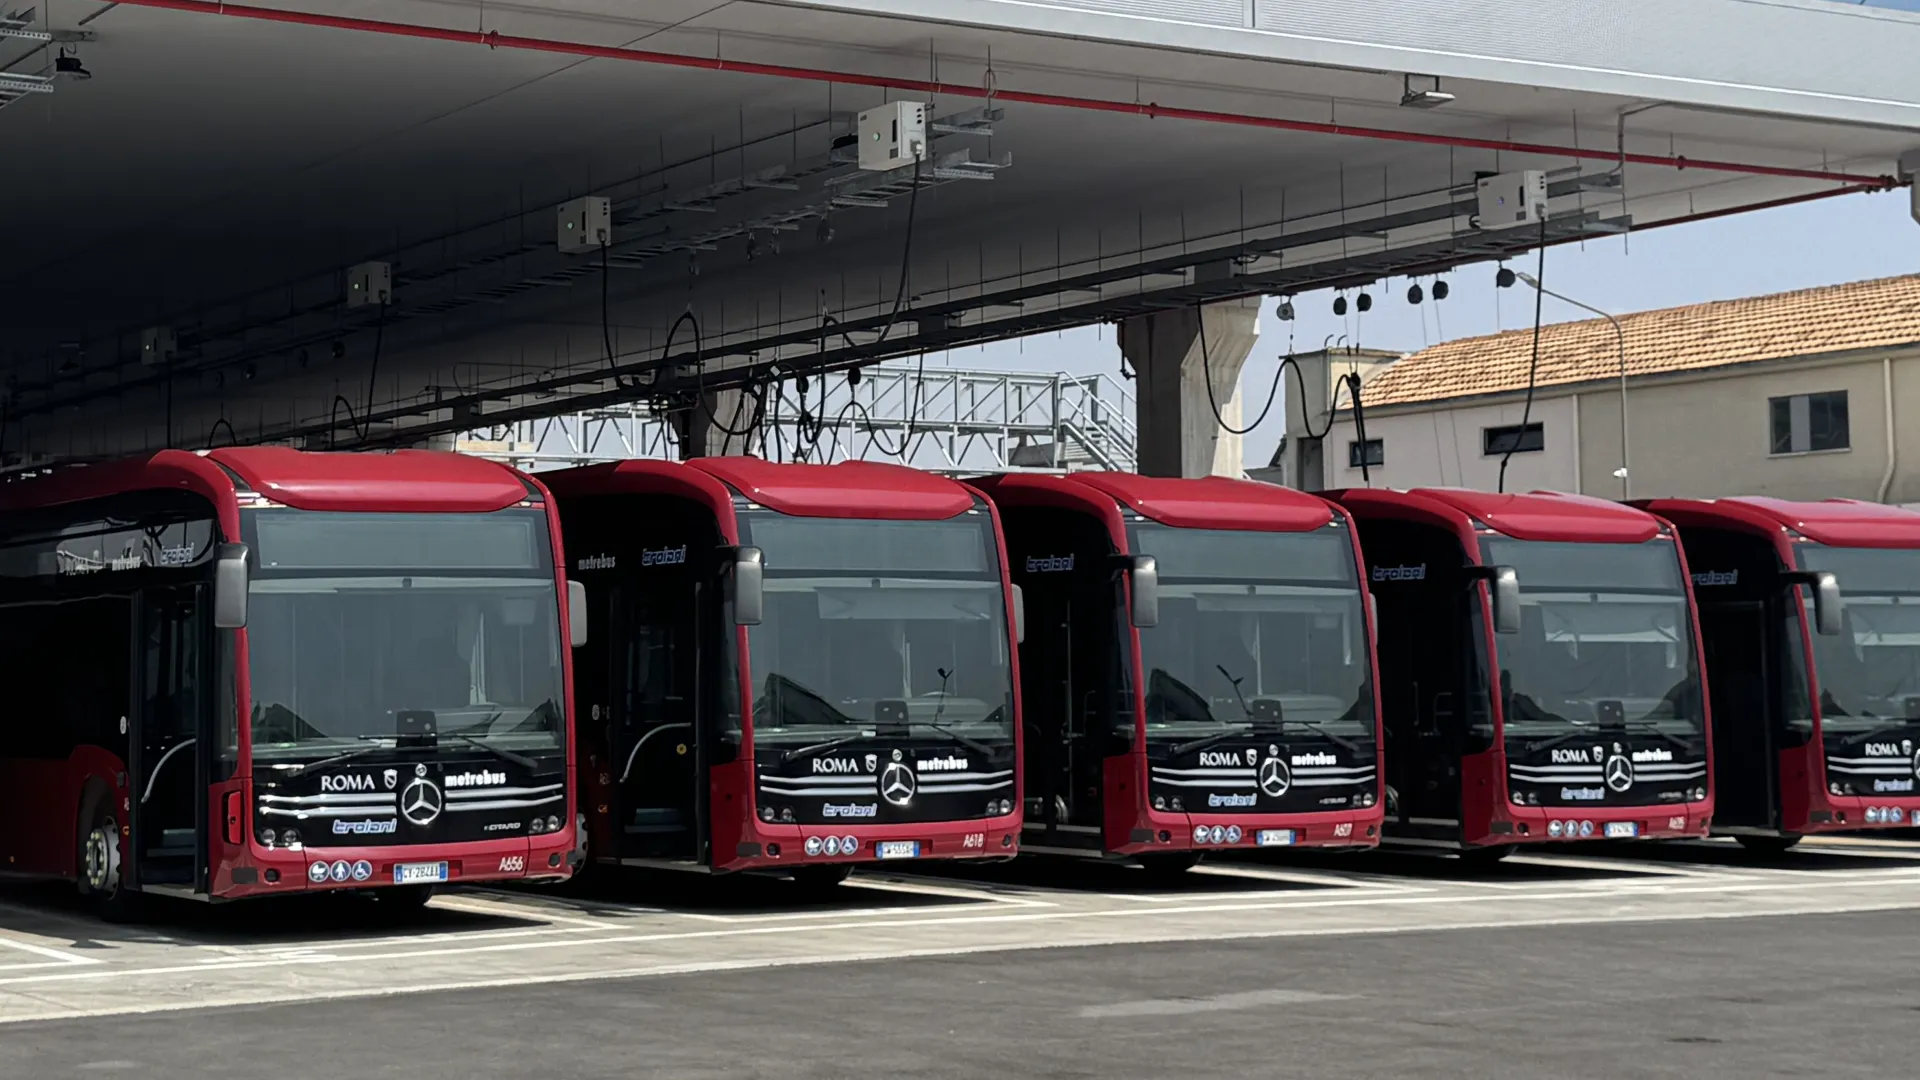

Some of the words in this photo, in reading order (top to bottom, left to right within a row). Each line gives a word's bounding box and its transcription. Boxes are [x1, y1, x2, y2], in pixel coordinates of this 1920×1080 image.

[642, 544, 686, 566] troiani
[1026, 553, 1075, 572] troiani
[1372, 563, 1426, 581] troiani
[1691, 568, 1738, 585] roiani
[1552, 749, 1589, 763] ROMA
[1865, 743, 1900, 756] ROMA
[812, 758, 859, 773] ROMA
[1200, 752, 1241, 766] ROMA
[321, 775, 375, 791] ROMA
[445, 770, 506, 787] metrebus
[1208, 793, 1258, 807] troiani
[823, 803, 878, 817] troiani
[332, 818, 398, 834] troiani
[499, 856, 524, 871] A656
